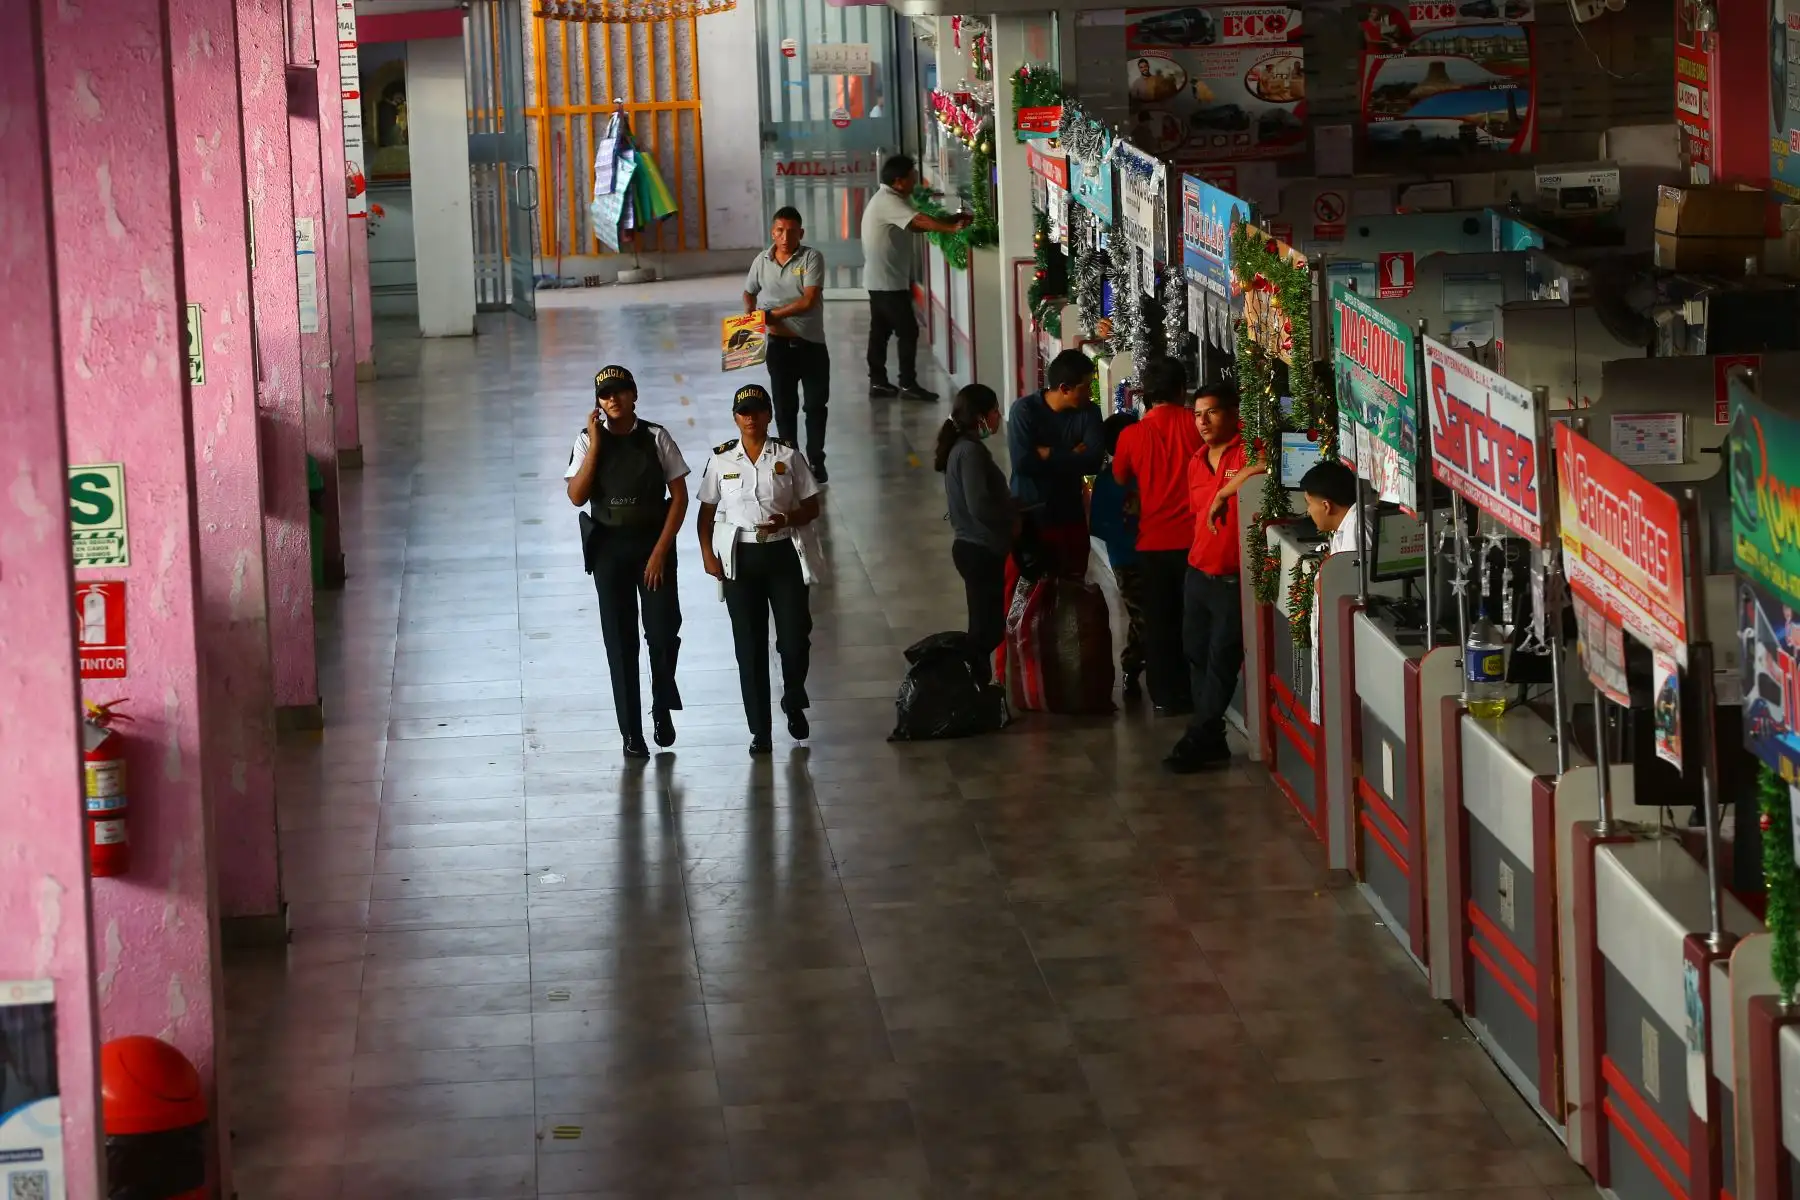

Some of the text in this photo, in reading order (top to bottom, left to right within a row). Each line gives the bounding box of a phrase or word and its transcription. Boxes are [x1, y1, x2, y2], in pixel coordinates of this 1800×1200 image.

[1410, 6, 1456, 21] ECO
[1224, 15, 1287, 37] ECO
[1341, 303, 1408, 397] NACIONAL
[596, 367, 624, 386] POLICIA
[737, 388, 764, 404] POLICIA
[70, 472, 114, 525] S
[80, 658, 124, 670] TINTOR
